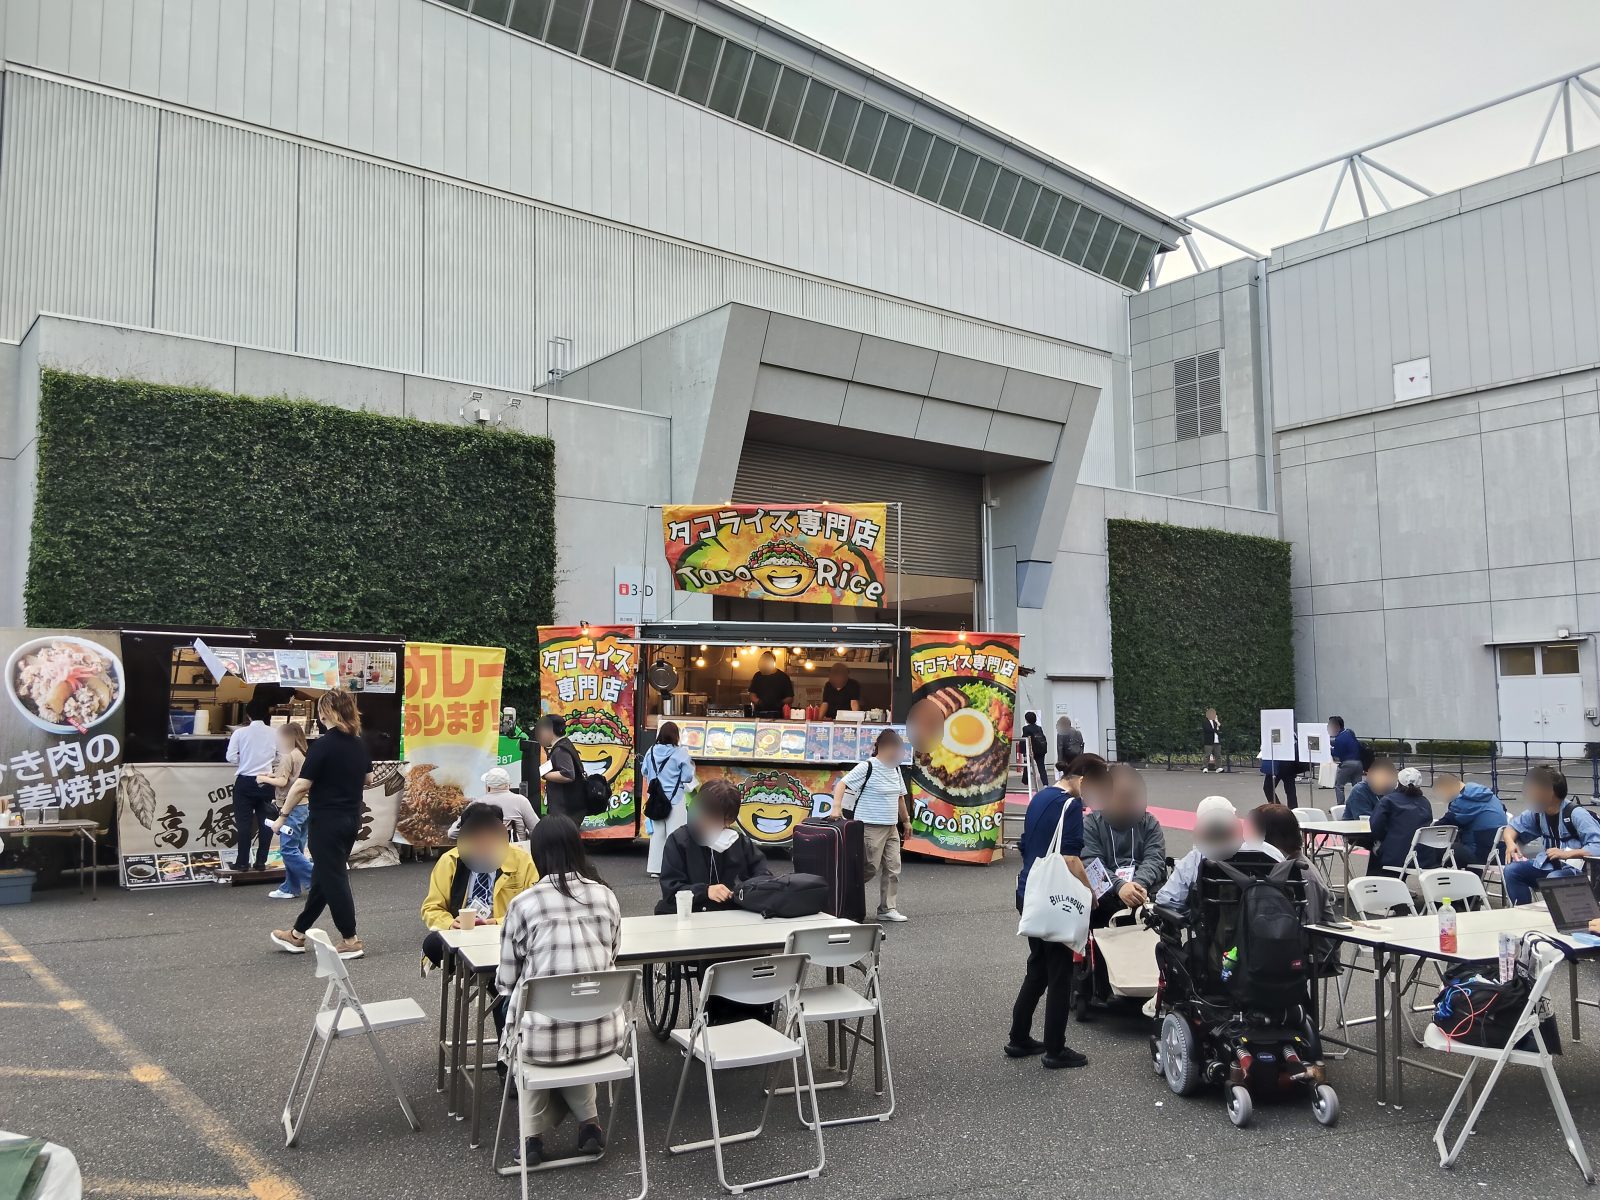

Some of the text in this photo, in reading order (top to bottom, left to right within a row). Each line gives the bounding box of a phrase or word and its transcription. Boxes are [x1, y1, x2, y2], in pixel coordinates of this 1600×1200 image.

[668, 509, 881, 551] タコライス専門店
[631, 583, 654, 597] 3-D
[676, 558, 884, 600] Taco Rice
[404, 647, 504, 699] カレー
[542, 645, 632, 674] タコライス
[913, 654, 1017, 678] タコライス専門店
[556, 675, 624, 703] 専門店
